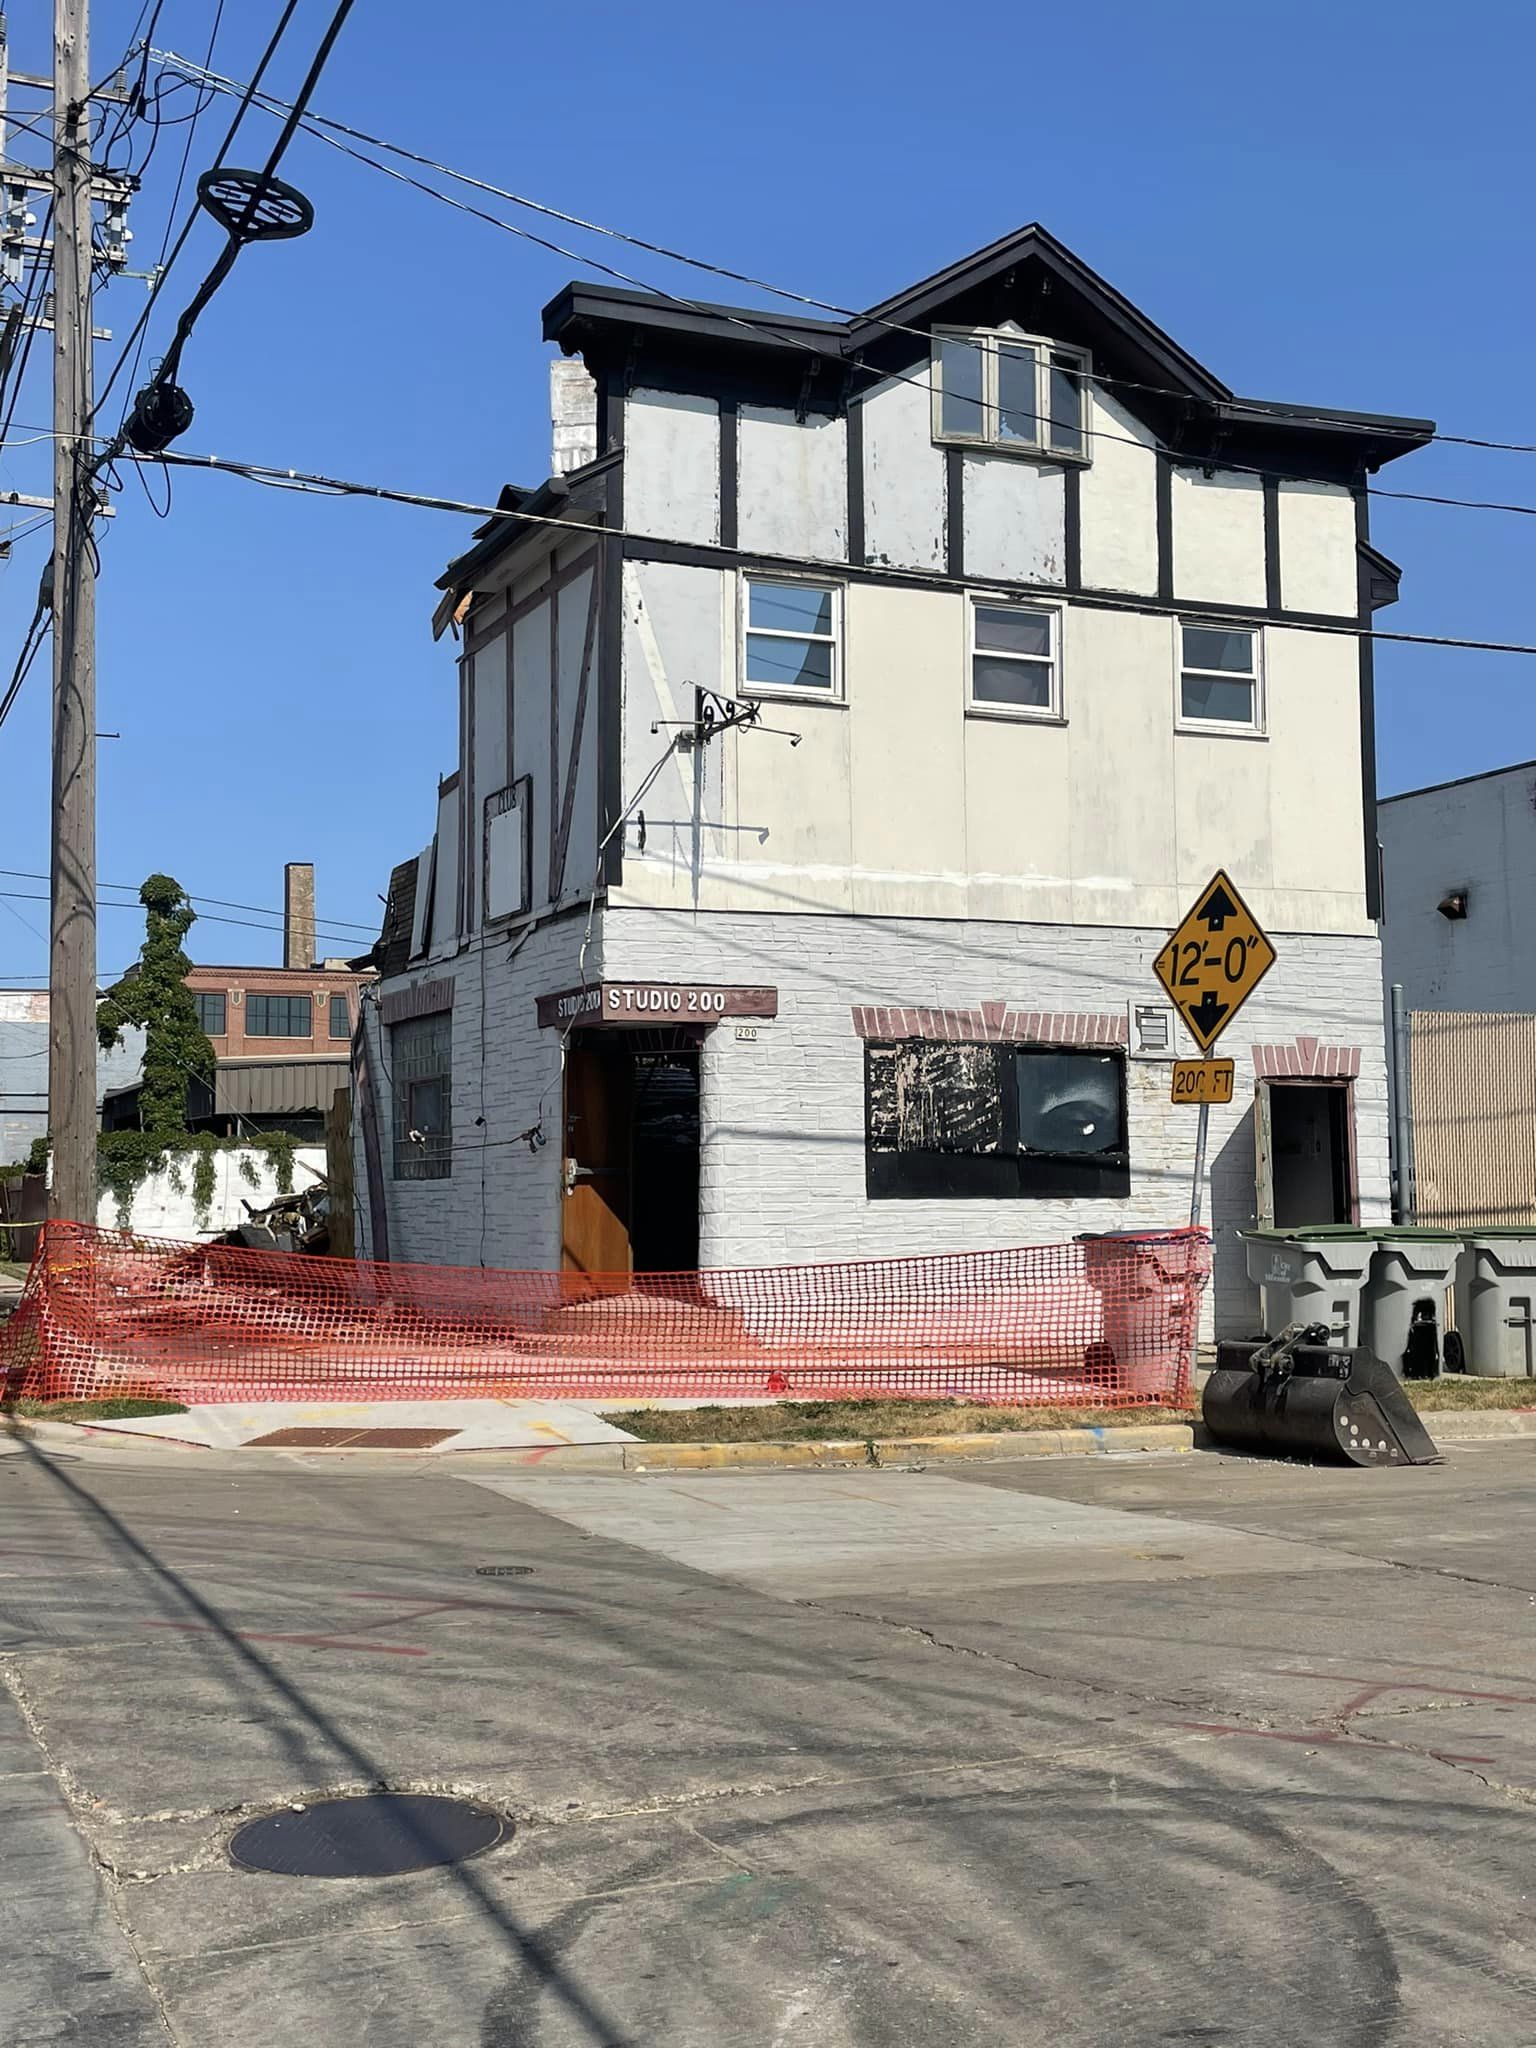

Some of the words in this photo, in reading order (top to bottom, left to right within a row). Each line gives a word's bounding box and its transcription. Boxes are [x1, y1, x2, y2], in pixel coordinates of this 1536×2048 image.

[608, 989, 681, 1011] STUDIO
[688, 991, 725, 1012] 200
[737, 1028, 757, 1037] 200
[1212, 1069, 1233, 1093] FT
